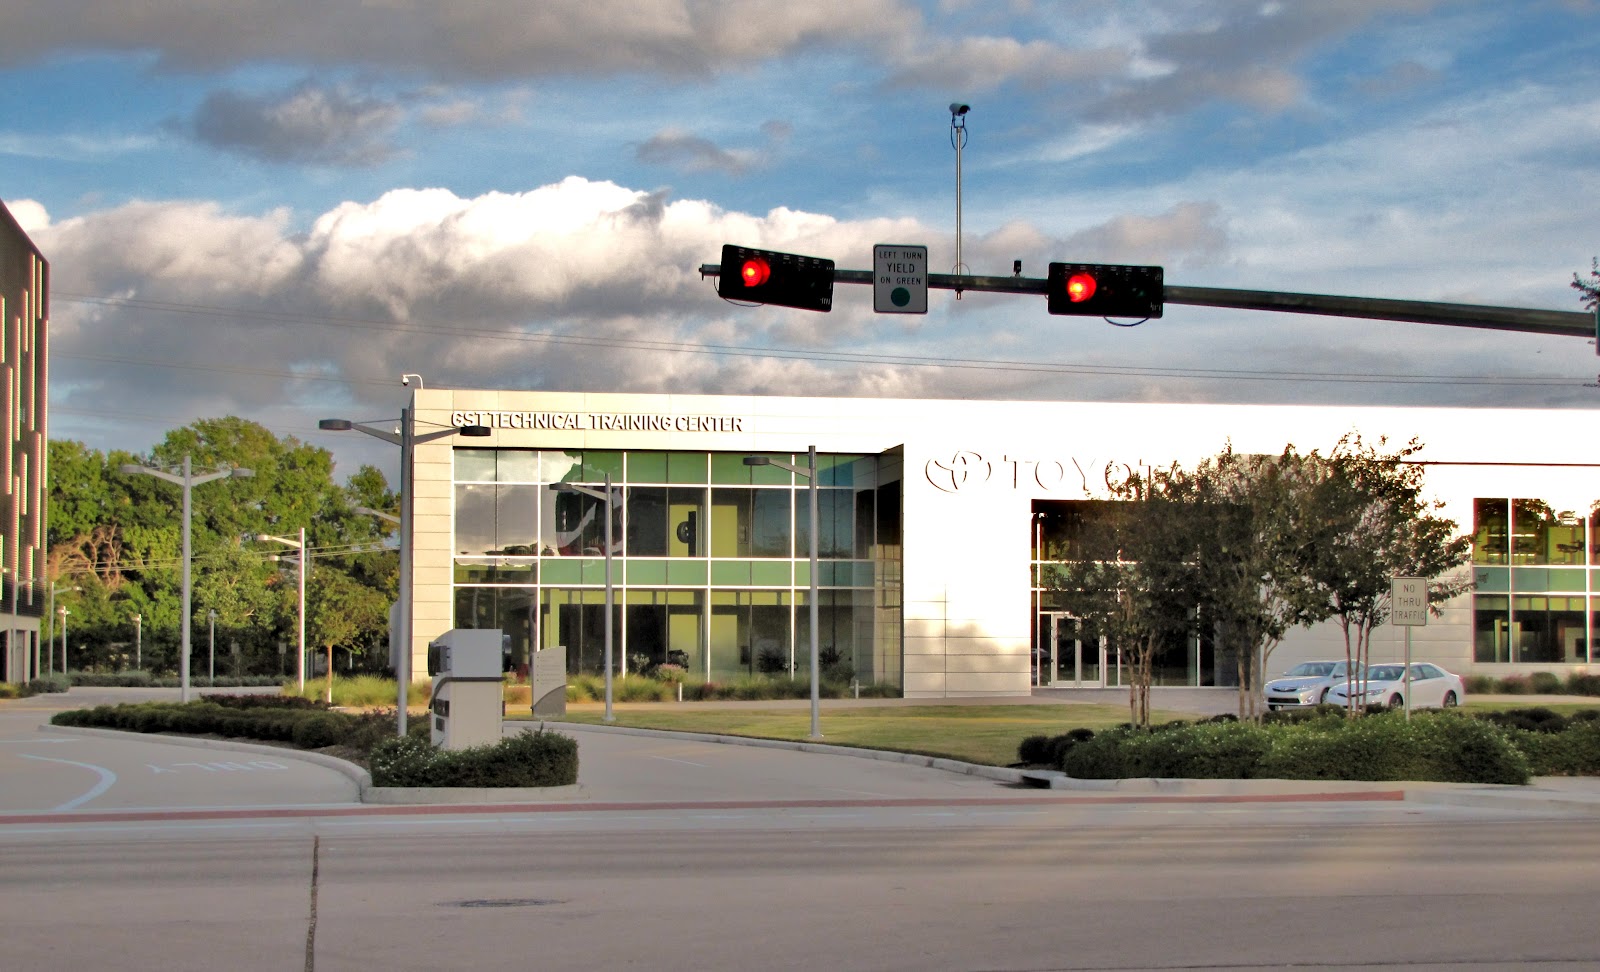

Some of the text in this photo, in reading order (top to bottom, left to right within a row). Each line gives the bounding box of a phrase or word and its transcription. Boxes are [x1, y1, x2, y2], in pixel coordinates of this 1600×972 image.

[879, 251, 922, 260] LEFT TURN
[887, 263, 915, 274] YIELD
[880, 276, 921, 285] ON GREEN
[451, 411, 743, 432] GST TECHNICAL TRAINING CENTER
[1403, 584, 1415, 593] NO
[1399, 597, 1421, 607] THRU
[1394, 610, 1425, 620] TRAFFIC
[144, 760, 289, 774] ONLY
